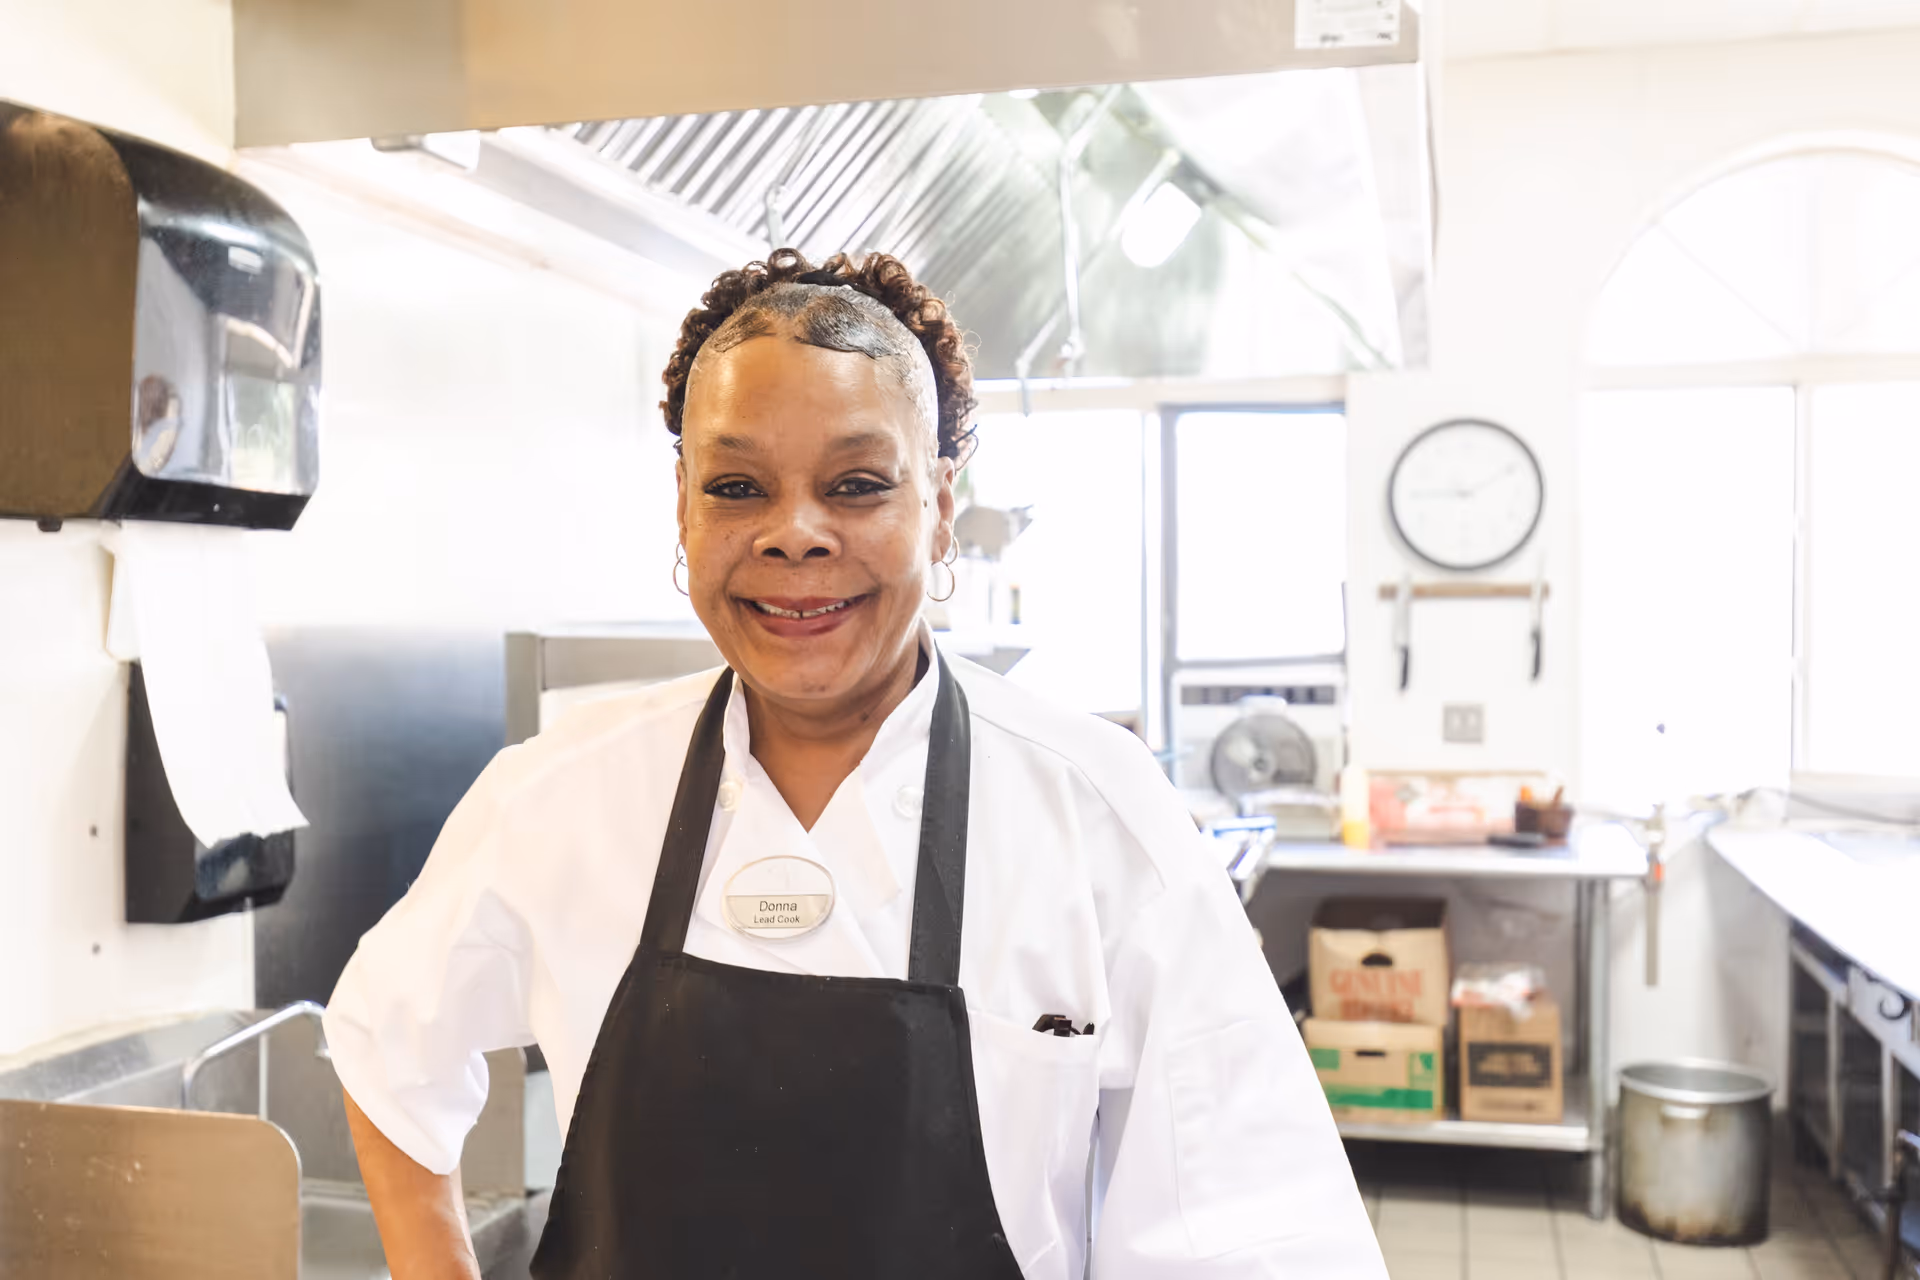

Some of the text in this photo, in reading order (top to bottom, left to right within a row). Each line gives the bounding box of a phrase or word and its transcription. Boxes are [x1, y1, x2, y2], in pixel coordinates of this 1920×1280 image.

[759, 900, 798, 912] Donna
[753, 915, 801, 924] Lead Cook
